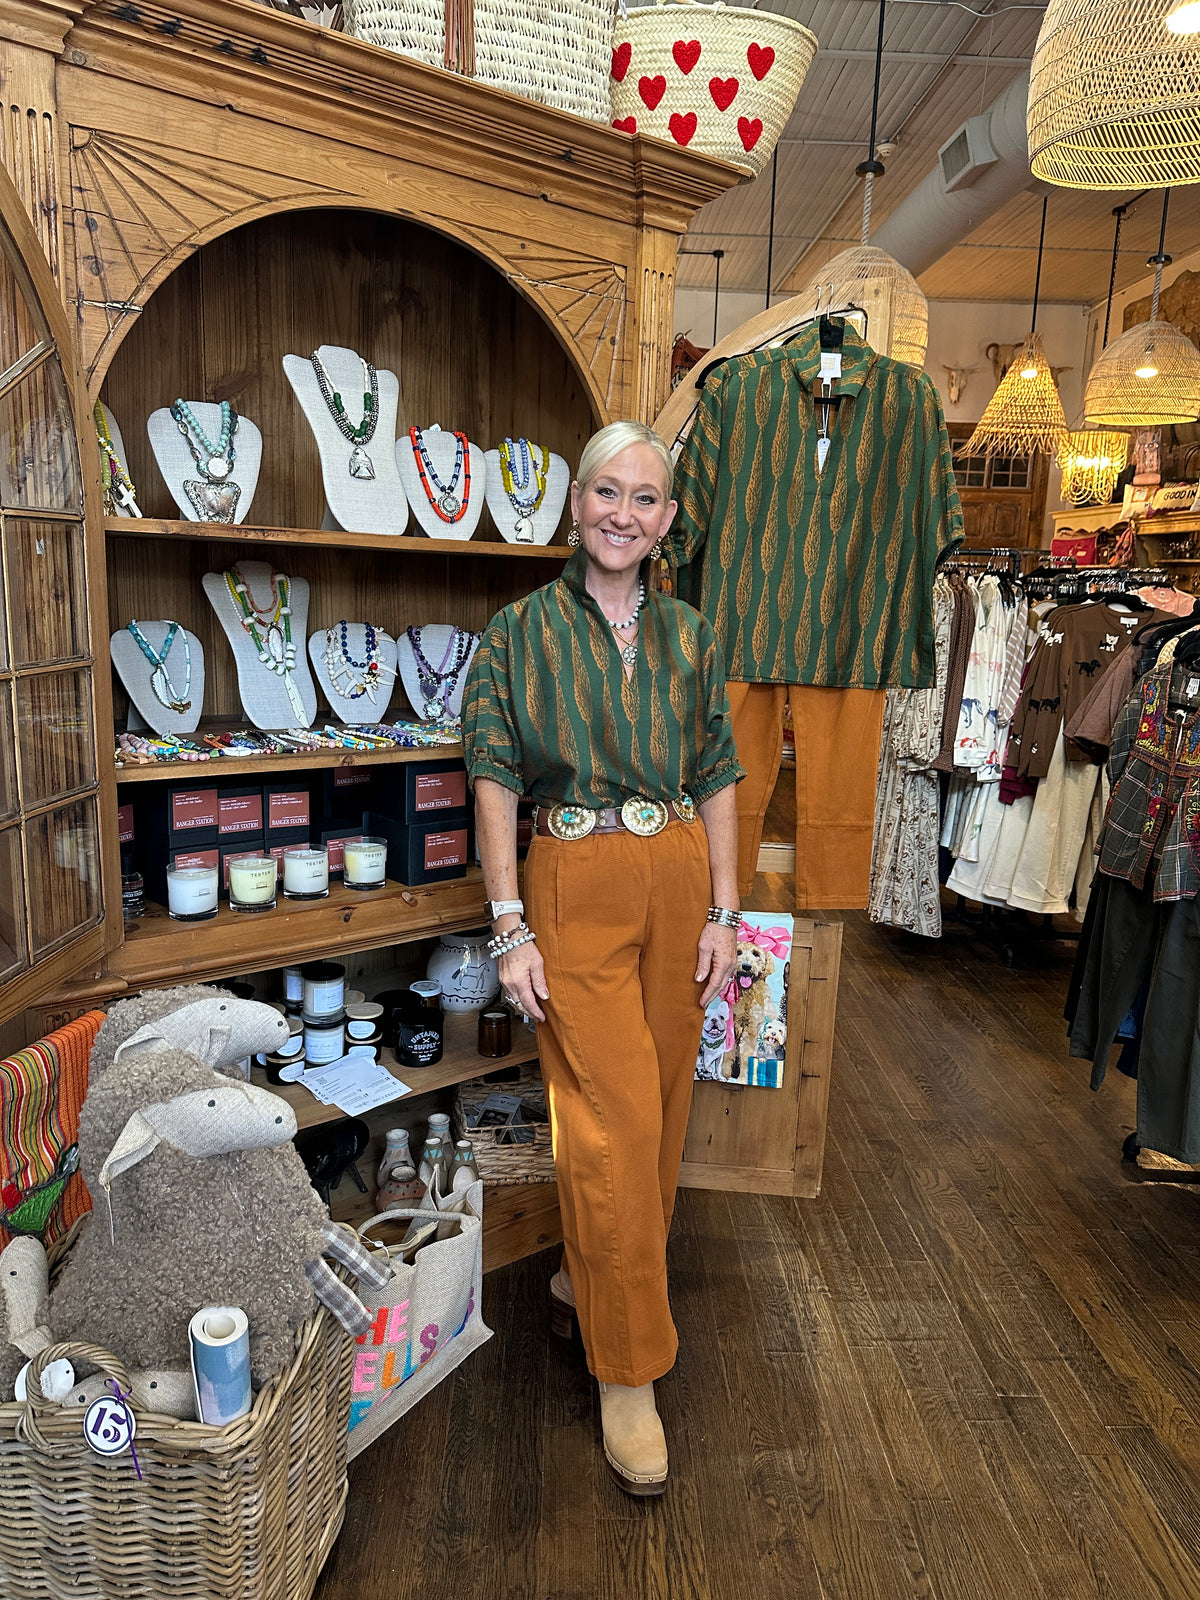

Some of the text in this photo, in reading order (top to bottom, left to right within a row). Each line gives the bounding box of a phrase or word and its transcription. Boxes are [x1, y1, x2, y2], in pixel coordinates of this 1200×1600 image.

[1164, 490, 1186, 501] GOOD
[417, 801, 435, 809] RANGER
[176, 820, 195, 828] RANGER
[195, 817, 214, 825] STATION
[289, 817, 308, 825] STATION
[221, 824, 240, 832] RANGER
[240, 822, 259, 830] STATION
[426, 860, 443, 868] RANGER
[443, 857, 460, 865] STATION
[250, 870, 271, 878] TESTER
[410, 1030, 440, 1044] UNTAMED
[413, 1041, 437, 1051] SUPPLY
